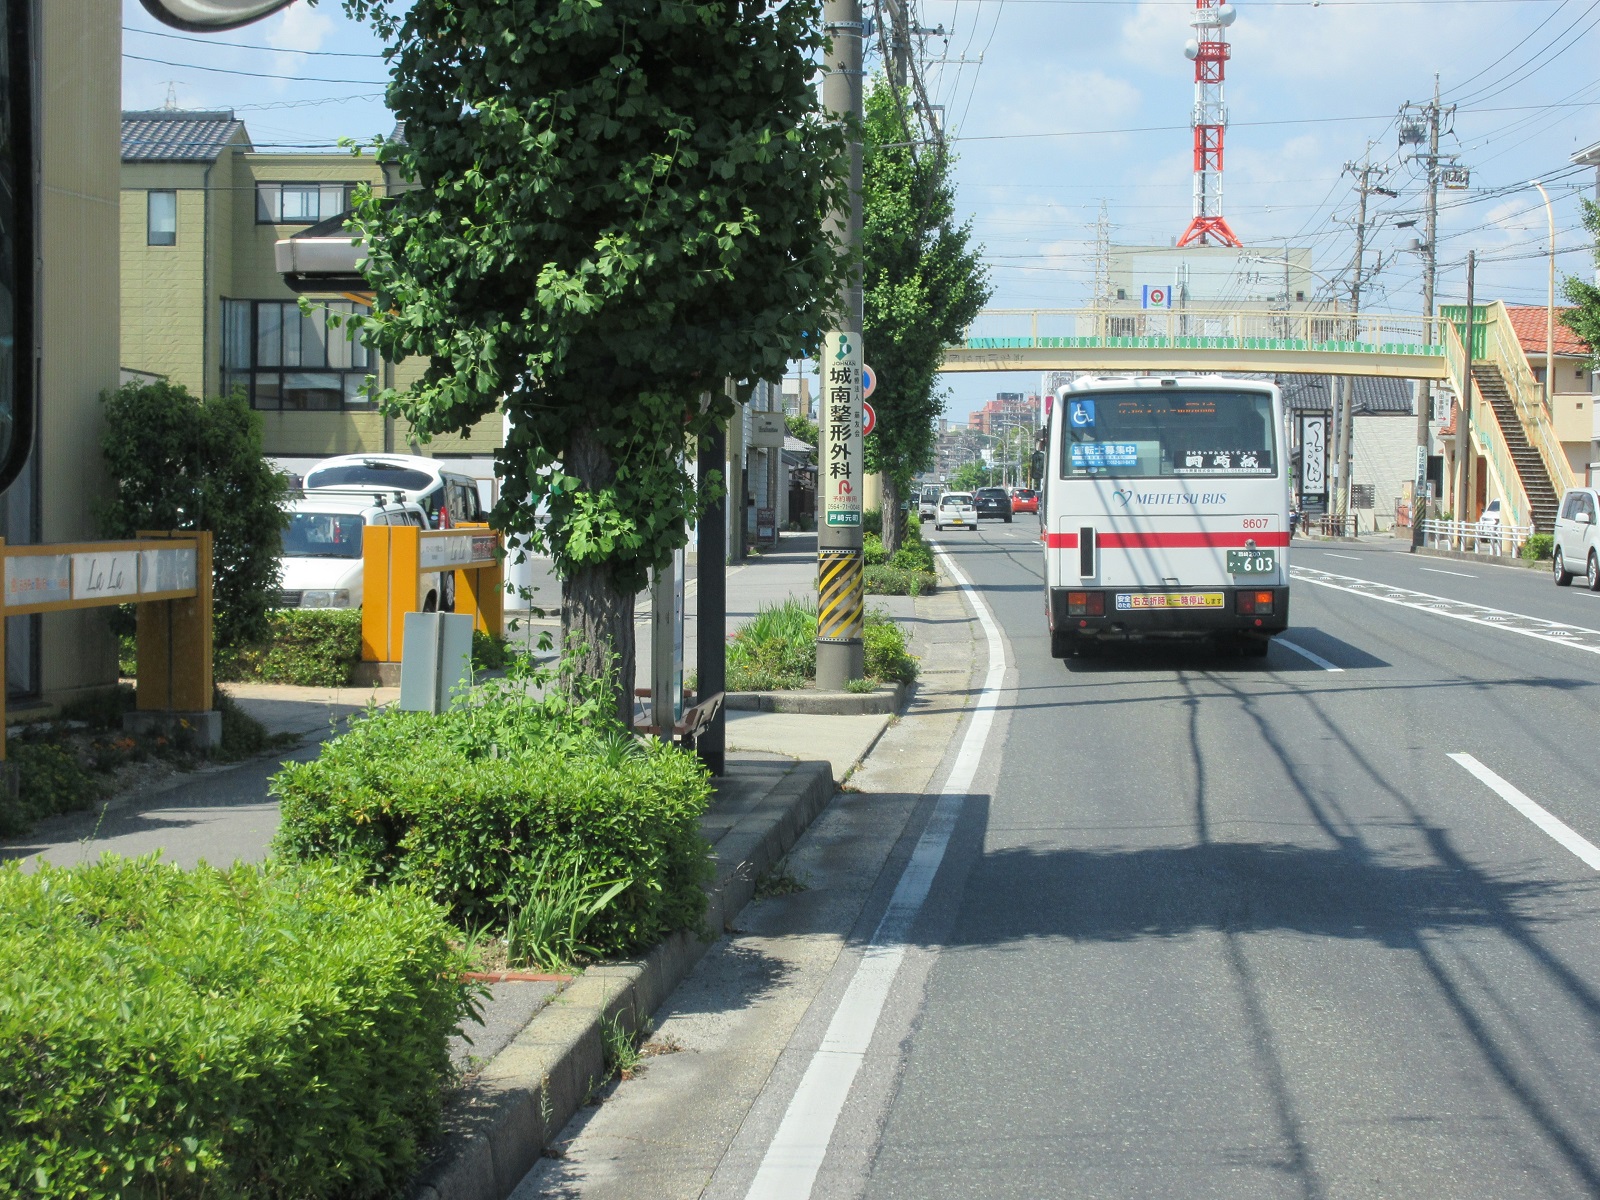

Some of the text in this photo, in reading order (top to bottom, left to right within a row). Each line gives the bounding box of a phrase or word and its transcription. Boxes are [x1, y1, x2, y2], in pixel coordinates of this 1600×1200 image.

[830, 367, 852, 480] 城南整形外科
[1073, 445, 1136, 455] 運転士募集中
[1135, 492, 1227, 505] MEITETSU BUS
[1242, 518, 1269, 529] 8607
[86, 558, 105, 592] La
[106, 557, 125, 590] La
[1132, 595, 1222, 606] 右左折時に一時停止します
